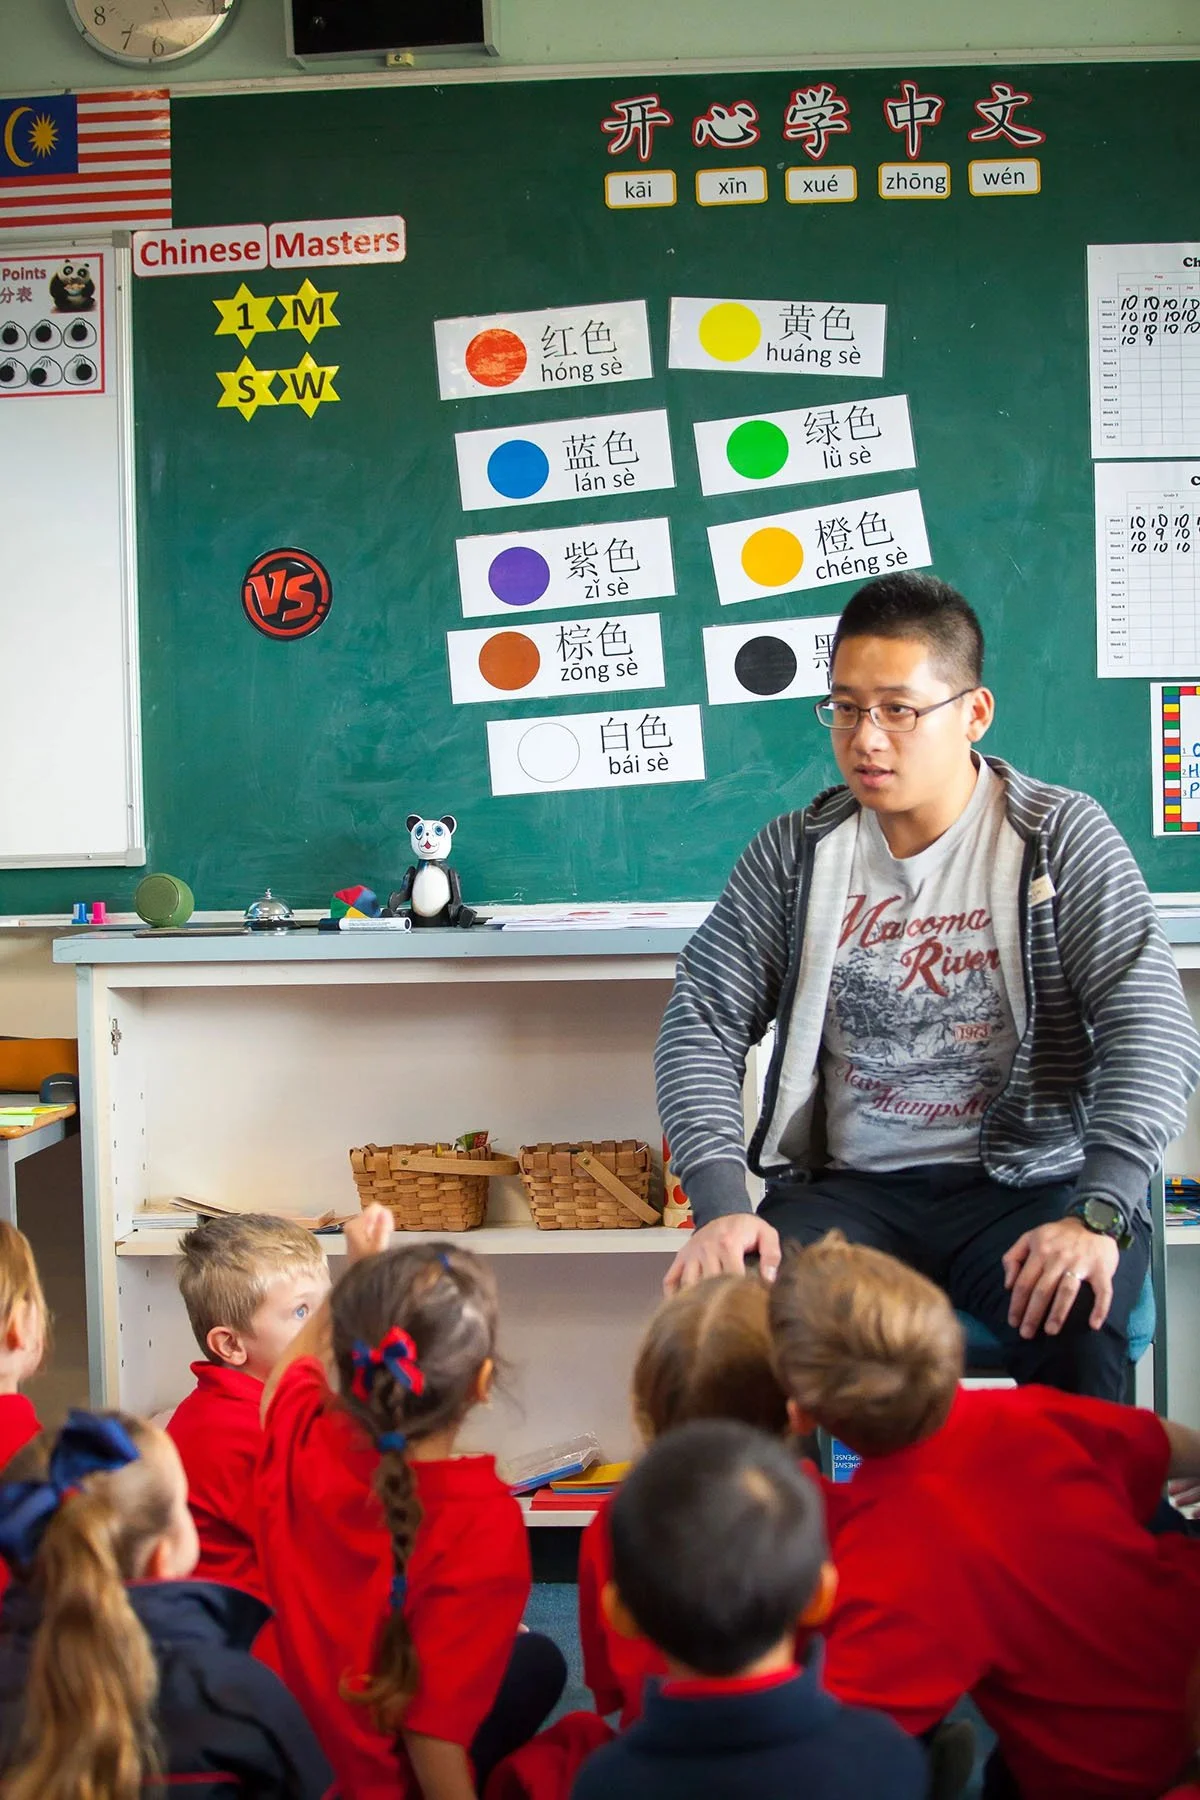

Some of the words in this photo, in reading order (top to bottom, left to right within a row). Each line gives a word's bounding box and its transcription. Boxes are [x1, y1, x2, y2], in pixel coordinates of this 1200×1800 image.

[94, 6, 106, 26] 8
[121, 30, 132, 50] 7
[152, 36, 165, 56] 6
[603, 82, 1044, 160] 开心学中文
[625, 180, 652, 198] kāi
[718, 177, 747, 195] xīn
[803, 176, 839, 194] xué
[886, 170, 947, 194] zhōng
[983, 168, 1026, 187] wén
[140, 236, 261, 267] Chinese
[275, 228, 400, 259] Masters
[2, 266, 47, 281] Points
[237, 304, 254, 330] 1
[293, 299, 325, 325] M
[1121, 295, 1138, 310] 10
[1144, 296, 1160, 310] 10
[1163, 299, 1178, 310] 10
[1182, 298, 1200, 310] 10
[779, 304, 855, 342] 黄色
[1121, 312, 1137, 321] 10
[1143, 311, 1158, 322] 10
[1165, 311, 1180, 322] 10
[1182, 310, 1197, 322] 10
[1122, 324, 1138, 335] 10
[1144, 324, 1157, 335] 10
[1164, 324, 1179, 334] 10
[1184, 322, 1200, 333] 10
[541, 319, 618, 359] 红色
[1122, 336, 1136, 345] 10
[1146, 334, 1153, 346] 9
[766, 342, 832, 367] huáng
[839, 345, 861, 365] sè
[541, 362, 594, 383] hóng
[601, 356, 623, 376] sè
[239, 375, 256, 403] S
[291, 371, 326, 399] W
[803, 405, 882, 447] 绿色
[562, 430, 640, 472] 蓝色
[850, 445, 872, 466] sè
[575, 473, 606, 493] lán
[613, 468, 636, 488] sè
[815, 511, 895, 557] 橙色
[1130, 516, 1146, 529] 10
[1151, 514, 1168, 528] 10
[1174, 513, 1189, 528] 10
[1131, 531, 1146, 541] 10
[1155, 528, 1165, 541] 9
[1175, 528, 1190, 539] 10
[1131, 543, 1147, 553] 10
[1153, 543, 1168, 553] 10
[1177, 542, 1190, 553] 10
[564, 537, 641, 580] 紫色
[816, 556, 880, 580] chéng
[886, 546, 908, 568] sè
[584, 579, 601, 599] zǐ
[607, 577, 629, 597] sè
[555, 621, 634, 663] 棕色
[560, 662, 609, 683] zōng
[616, 657, 639, 677] sè
[600, 713, 674, 754] 白色
[609, 754, 640, 775] bái
[647, 752, 669, 772] sè
[897, 935, 1001, 997] River
